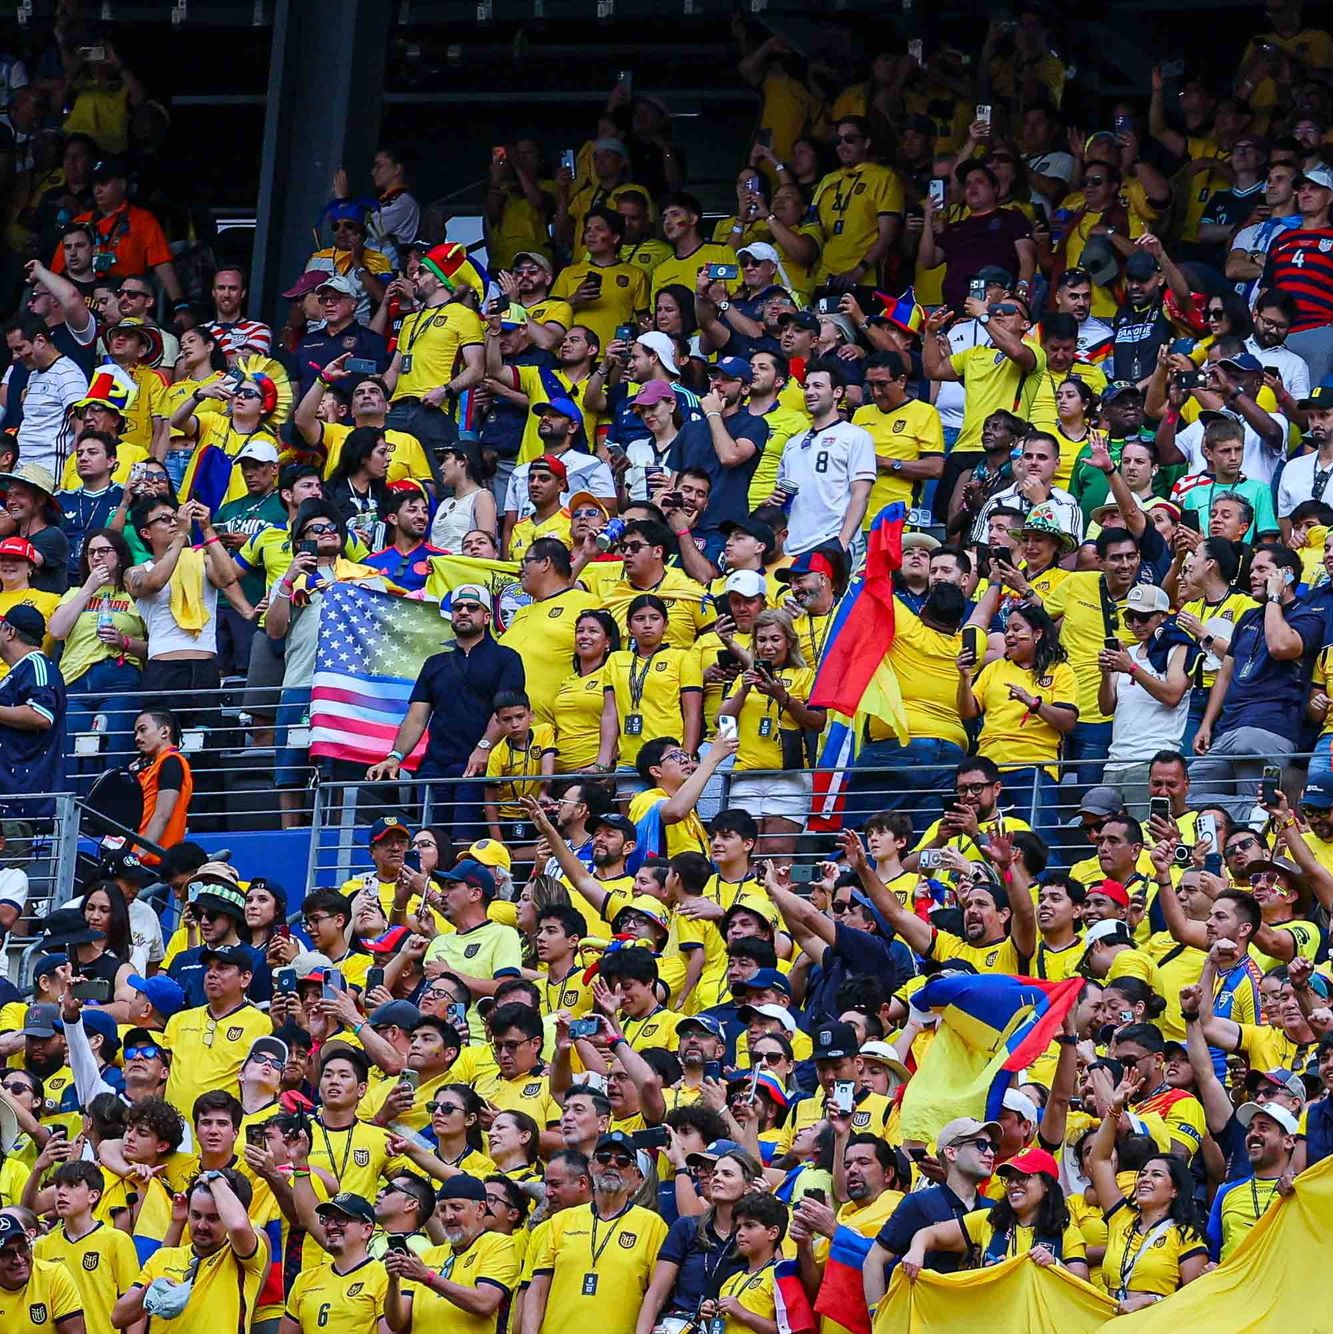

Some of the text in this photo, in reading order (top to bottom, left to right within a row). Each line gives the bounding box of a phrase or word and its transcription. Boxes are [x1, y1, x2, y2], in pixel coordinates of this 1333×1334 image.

[1291, 248, 1305, 268] 4
[815, 451, 829, 473] 8
[317, 1303, 331, 1327] 6
